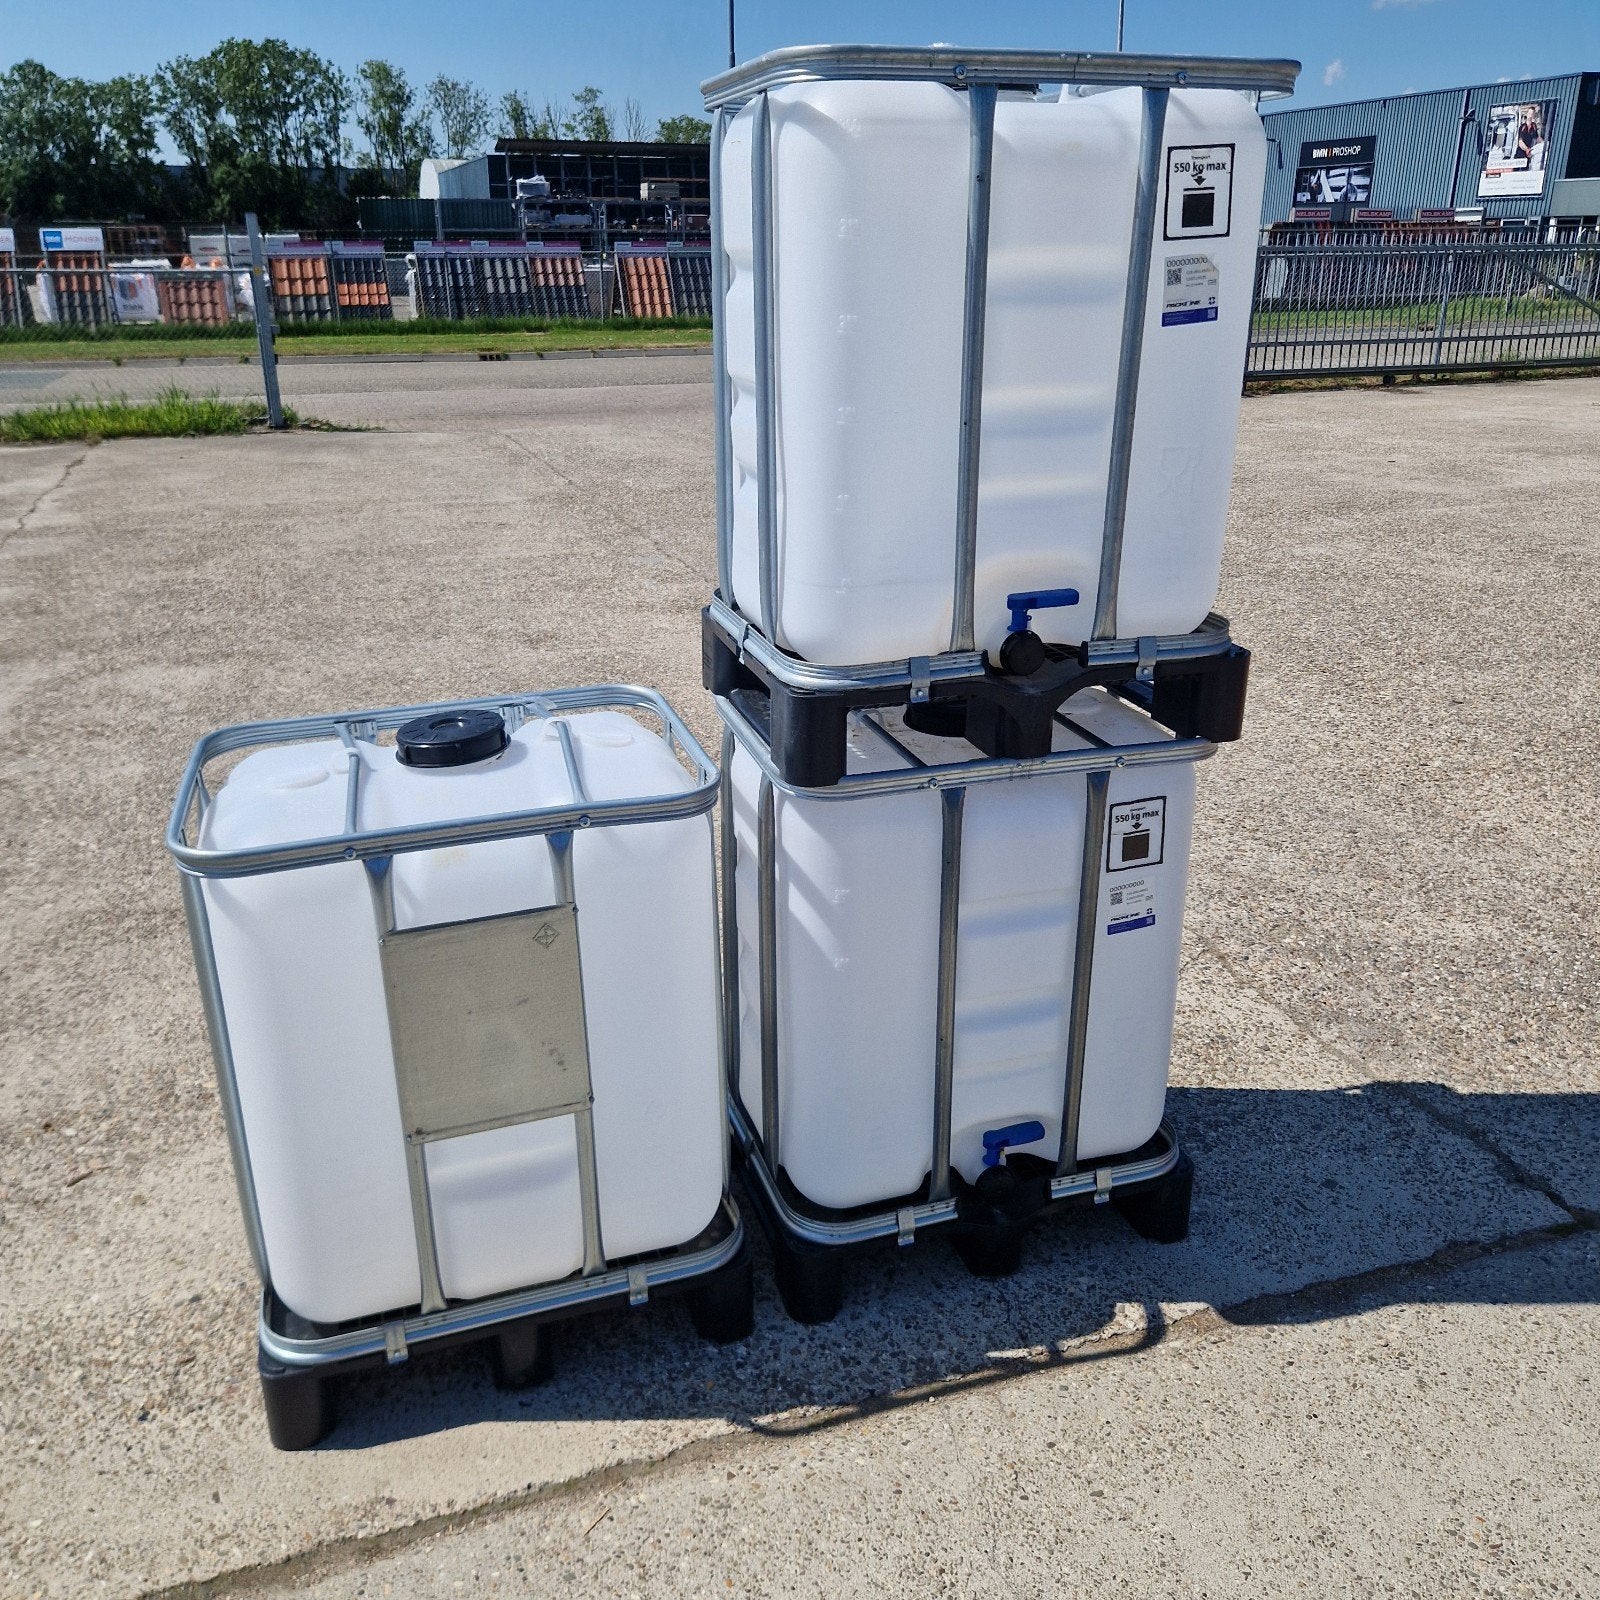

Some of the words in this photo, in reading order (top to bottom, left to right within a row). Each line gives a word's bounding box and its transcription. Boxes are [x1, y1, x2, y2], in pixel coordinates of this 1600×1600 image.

[1312, 148, 1328, 159] BMN
[1332, 145, 1362, 157] PROSHOP
[1173, 162, 1191, 173] 550
[1192, 161, 1205, 175] kg
[1206, 162, 1227, 171] max
[1115, 814, 1130, 823] 550
[1130, 812, 1141, 821] kg
[1142, 810, 1160, 818] max
